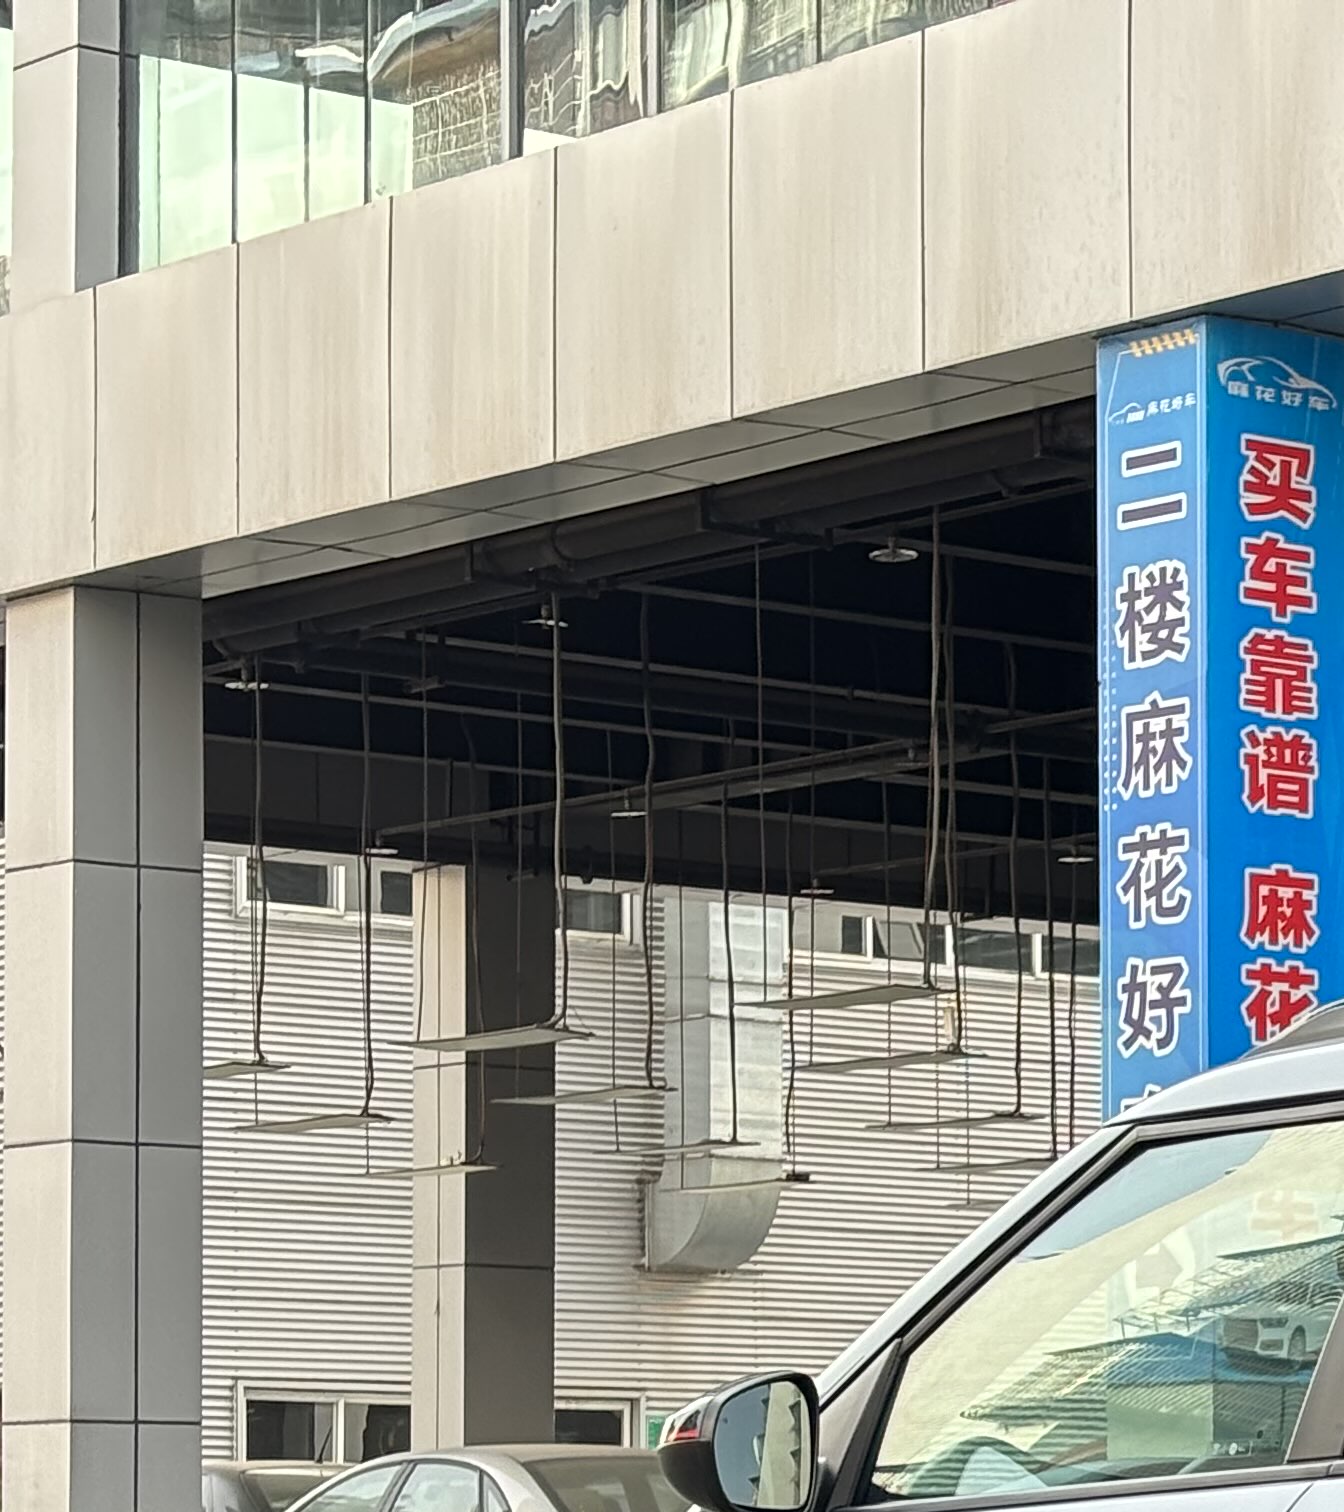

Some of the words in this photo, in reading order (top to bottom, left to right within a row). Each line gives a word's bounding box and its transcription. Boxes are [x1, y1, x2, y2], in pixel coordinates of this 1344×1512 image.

[1227, 380, 1330, 411] 麻花好车
[1115, 441, 1192, 1111] 二楼麻花好
[1240, 433, 1318, 819] 买车靠谱
